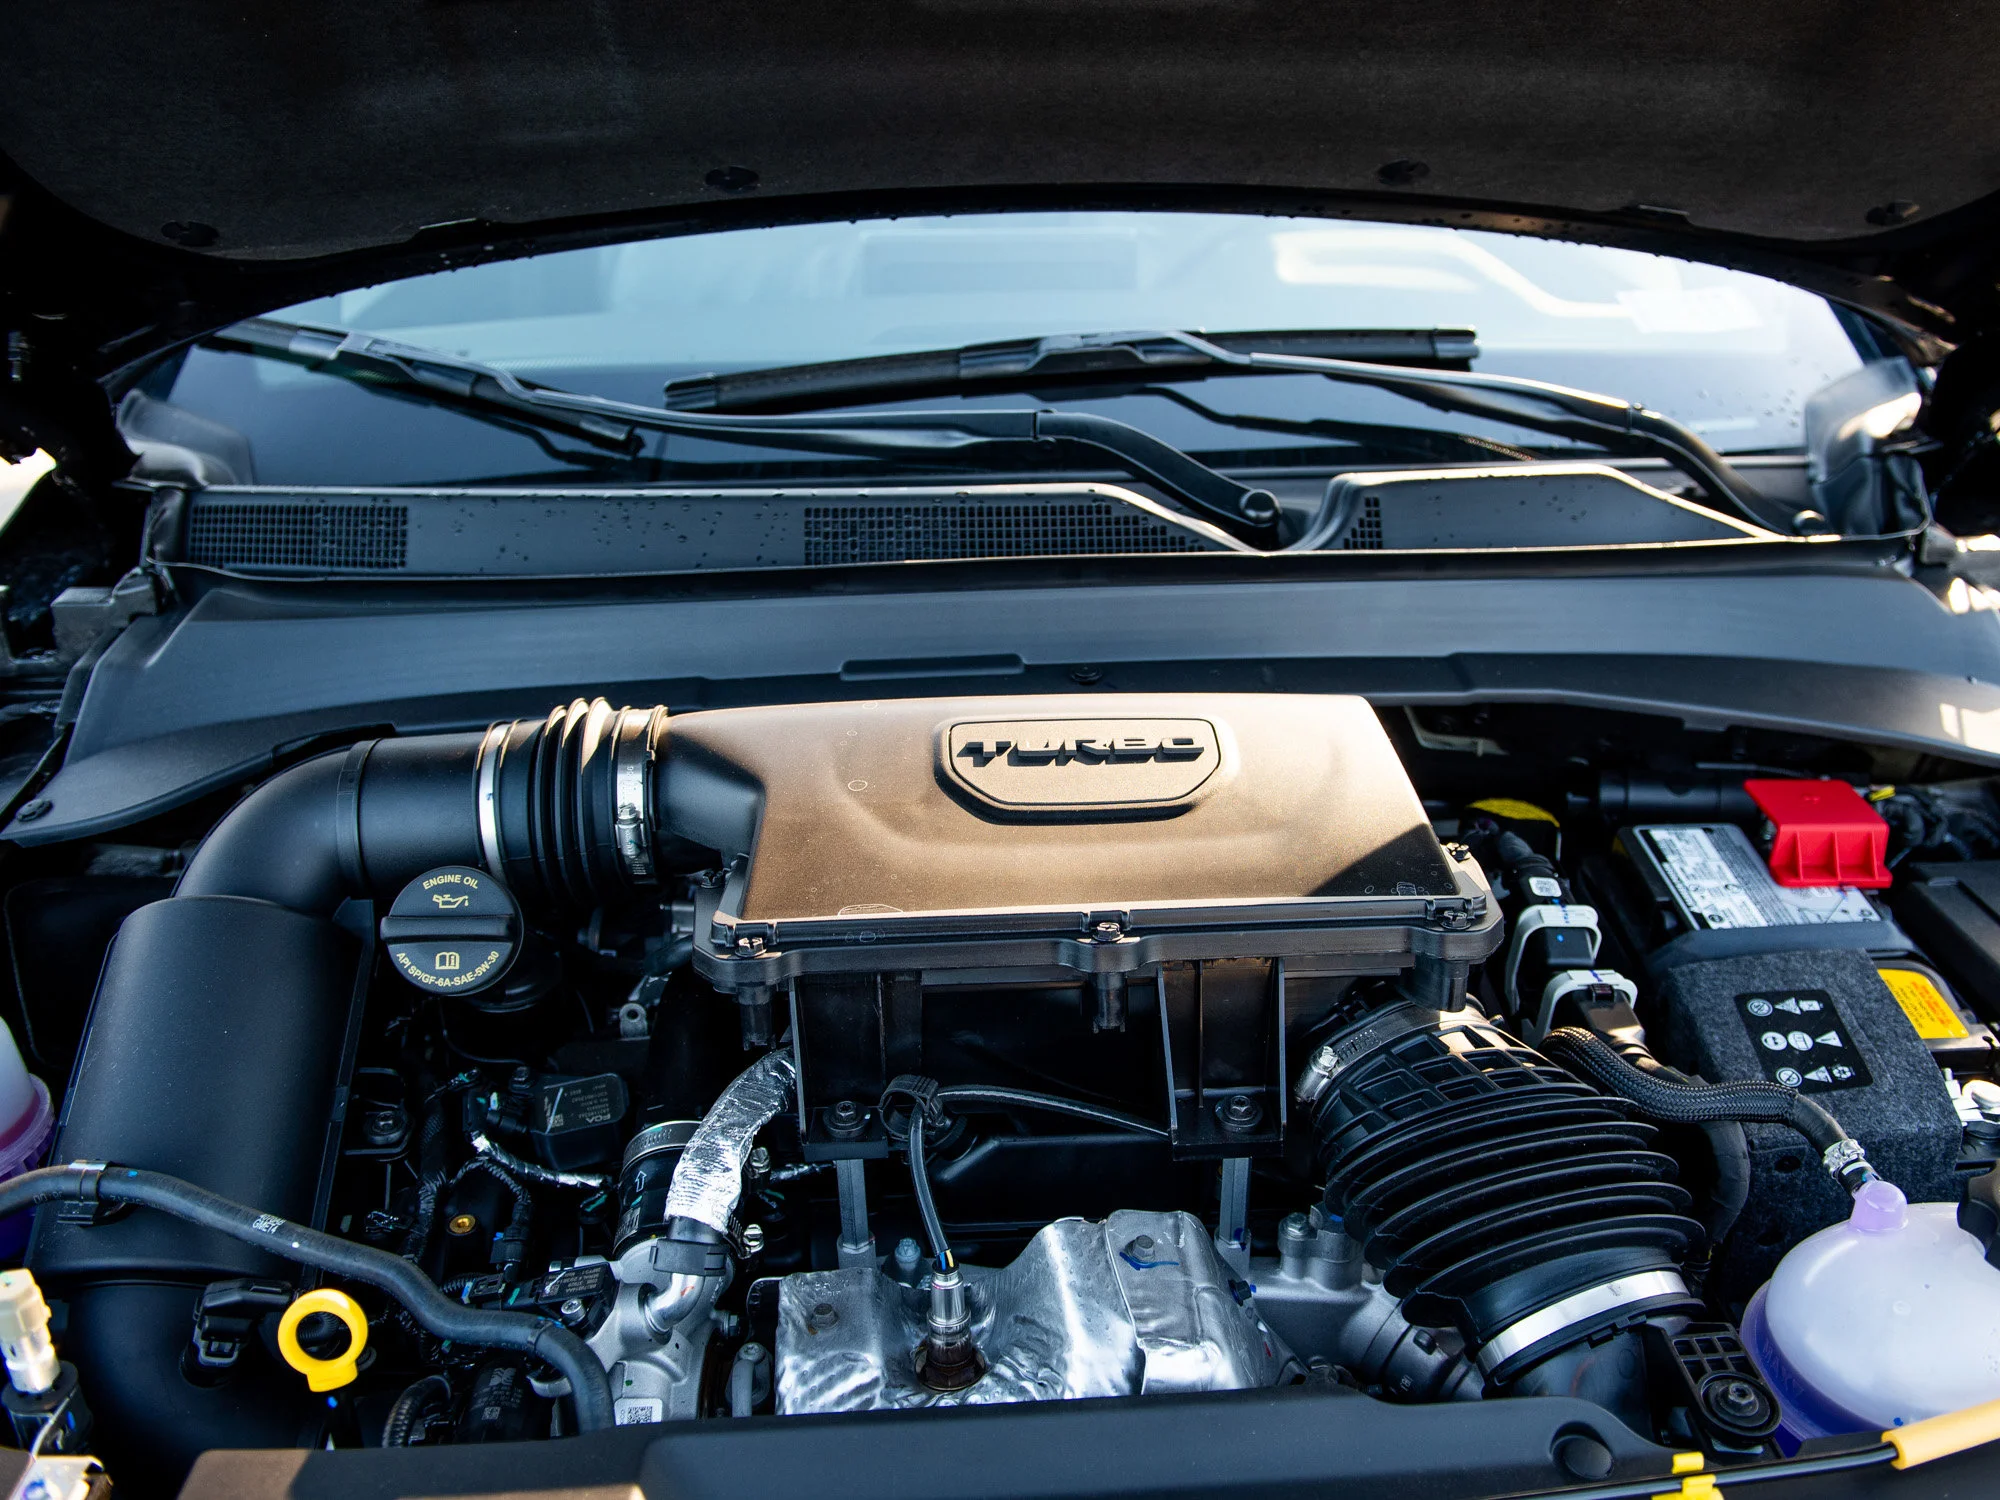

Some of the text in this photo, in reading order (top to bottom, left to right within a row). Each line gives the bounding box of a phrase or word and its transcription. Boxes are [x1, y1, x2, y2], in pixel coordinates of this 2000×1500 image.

[960, 737, 1205, 762] TURBO
[422, 874, 479, 889] ENGINE OIL
[396, 951, 499, 987] API SP/GF-6A-SAE-5W-30
